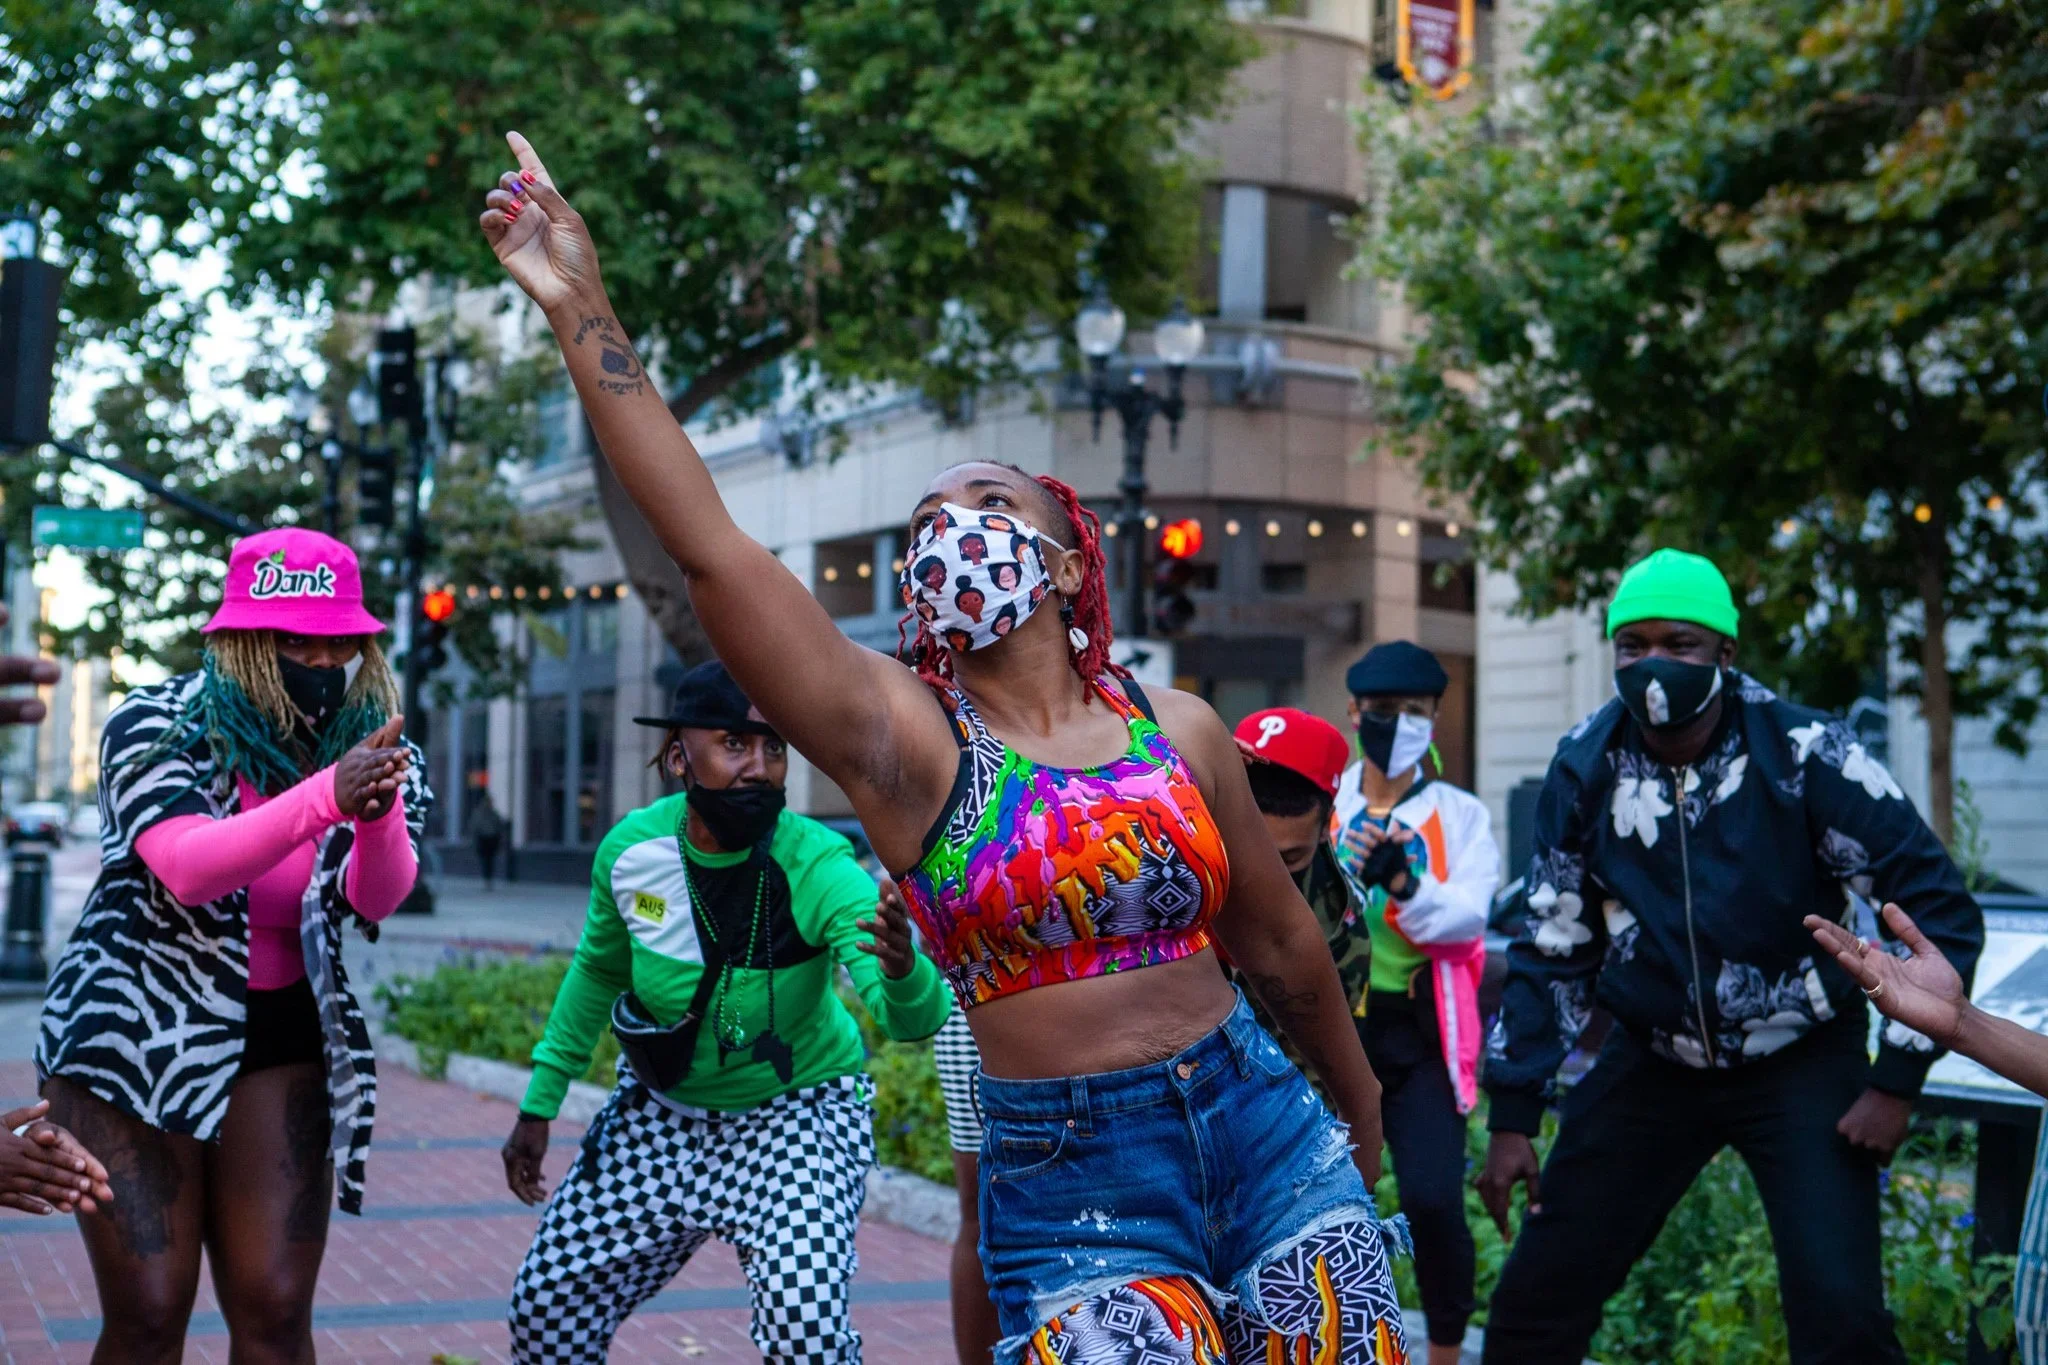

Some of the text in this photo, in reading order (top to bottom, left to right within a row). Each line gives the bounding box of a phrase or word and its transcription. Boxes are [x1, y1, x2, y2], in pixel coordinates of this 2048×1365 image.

[251, 561, 335, 598] Dank
[1255, 715, 1287, 749] P
[638, 897, 666, 918] AUS
